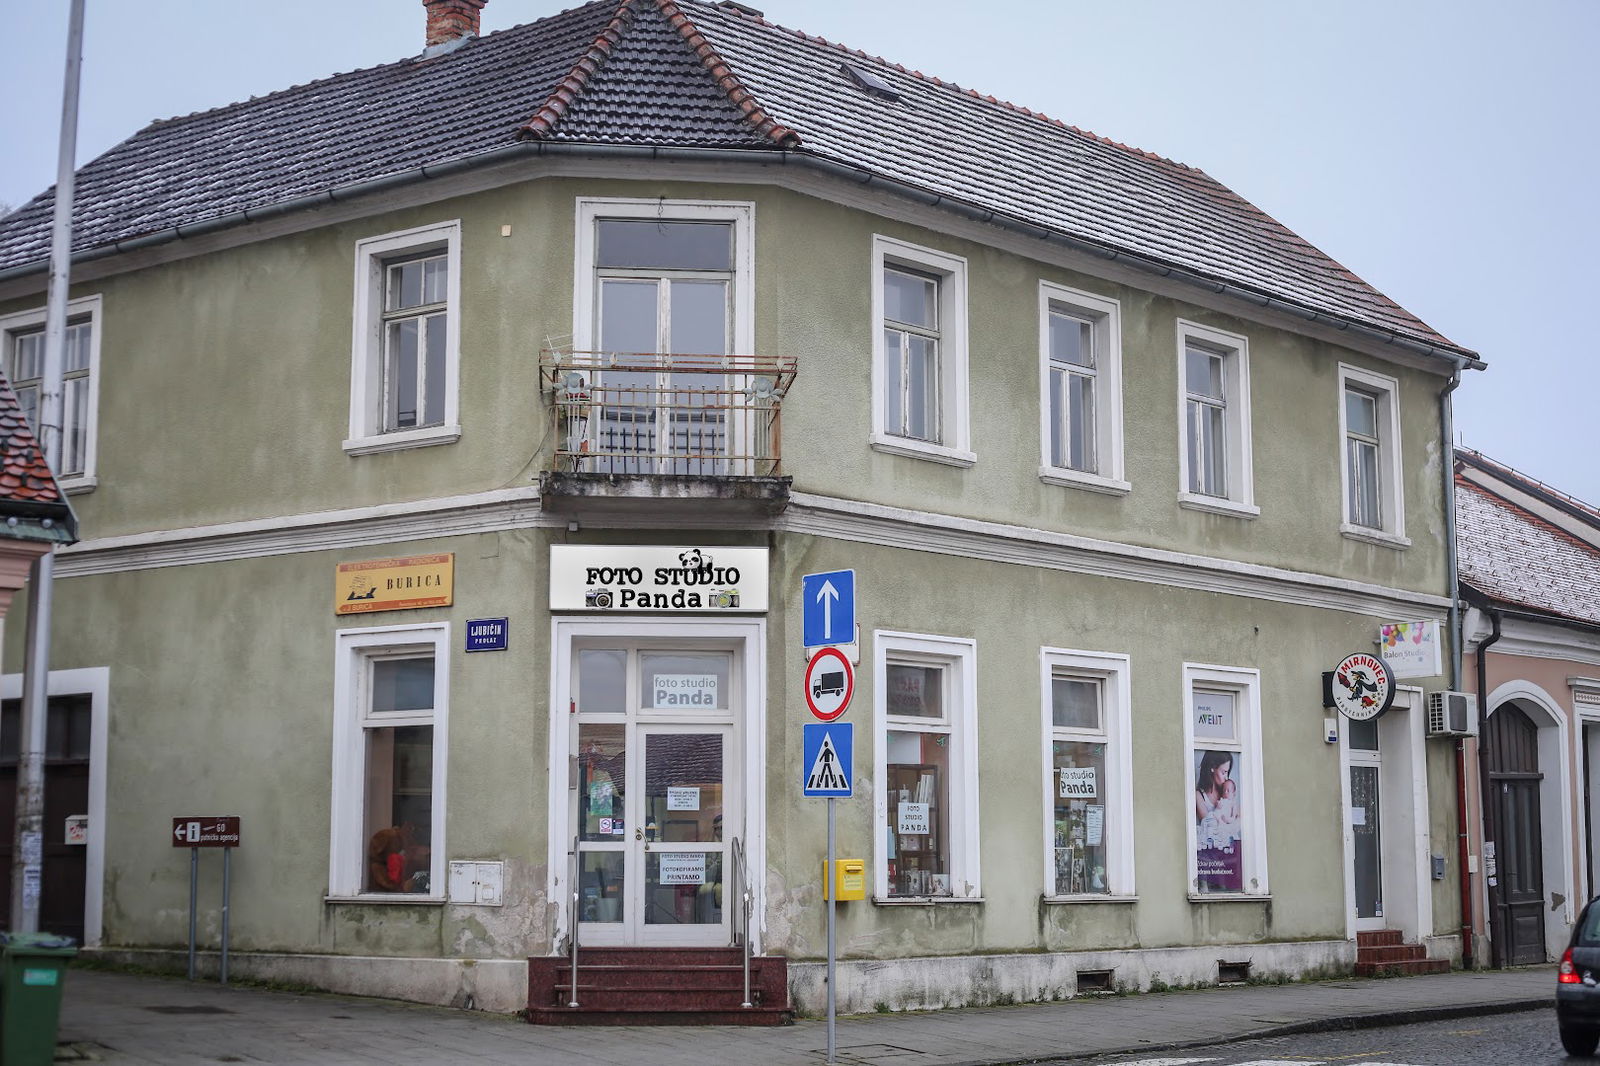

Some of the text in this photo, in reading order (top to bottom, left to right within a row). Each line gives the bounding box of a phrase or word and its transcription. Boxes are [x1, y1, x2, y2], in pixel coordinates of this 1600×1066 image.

[387, 574, 441, 590] BURICA
[586, 567, 740, 586] FOTO STUDIO
[620, 589, 702, 608] Panda
[471, 624, 502, 636] LJUBIČIN
[1341, 656, 1385, 684] MIRNOVEC
[655, 677, 716, 688] foto studio
[656, 689, 713, 705] Panda
[1071, 770, 1094, 779] studio
[1061, 780, 1094, 794] Panda
